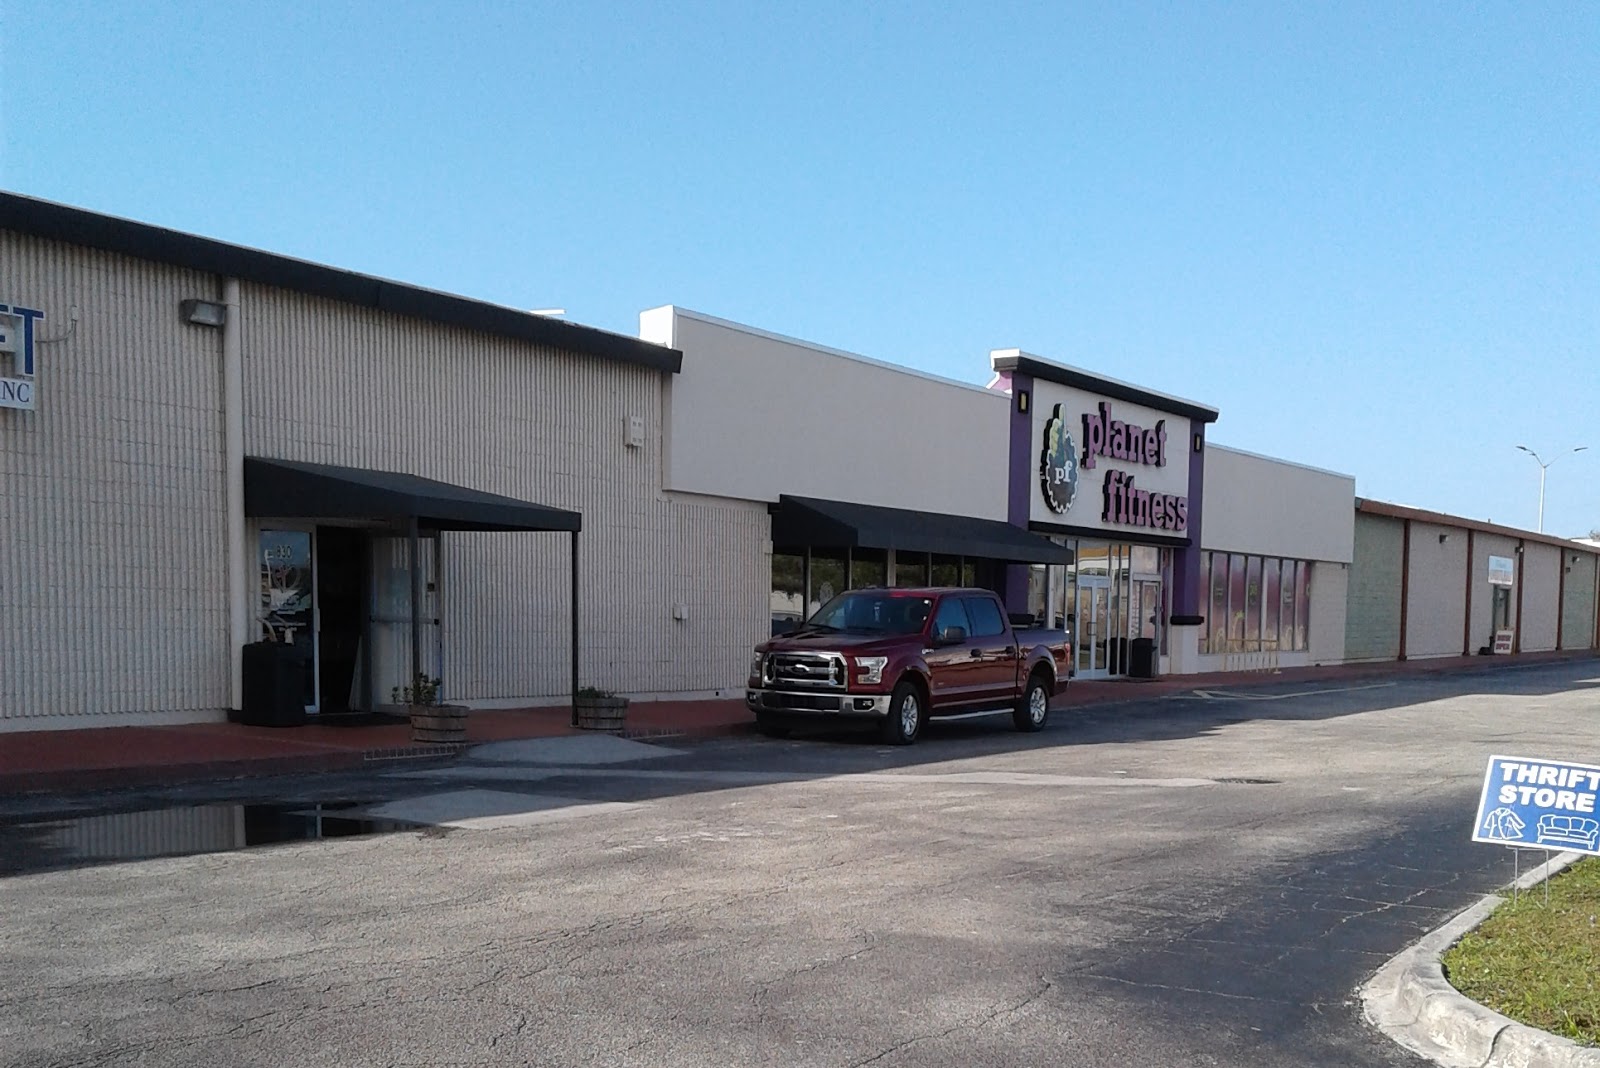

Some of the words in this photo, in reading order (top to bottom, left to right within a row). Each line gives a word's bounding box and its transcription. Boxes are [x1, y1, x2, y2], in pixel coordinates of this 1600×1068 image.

[1080, 401, 1167, 469] planet
[1102, 469, 1188, 531] fitness
[1498, 784, 1596, 813] STORE
[1500, 762, 1600, 791] THRIFT
